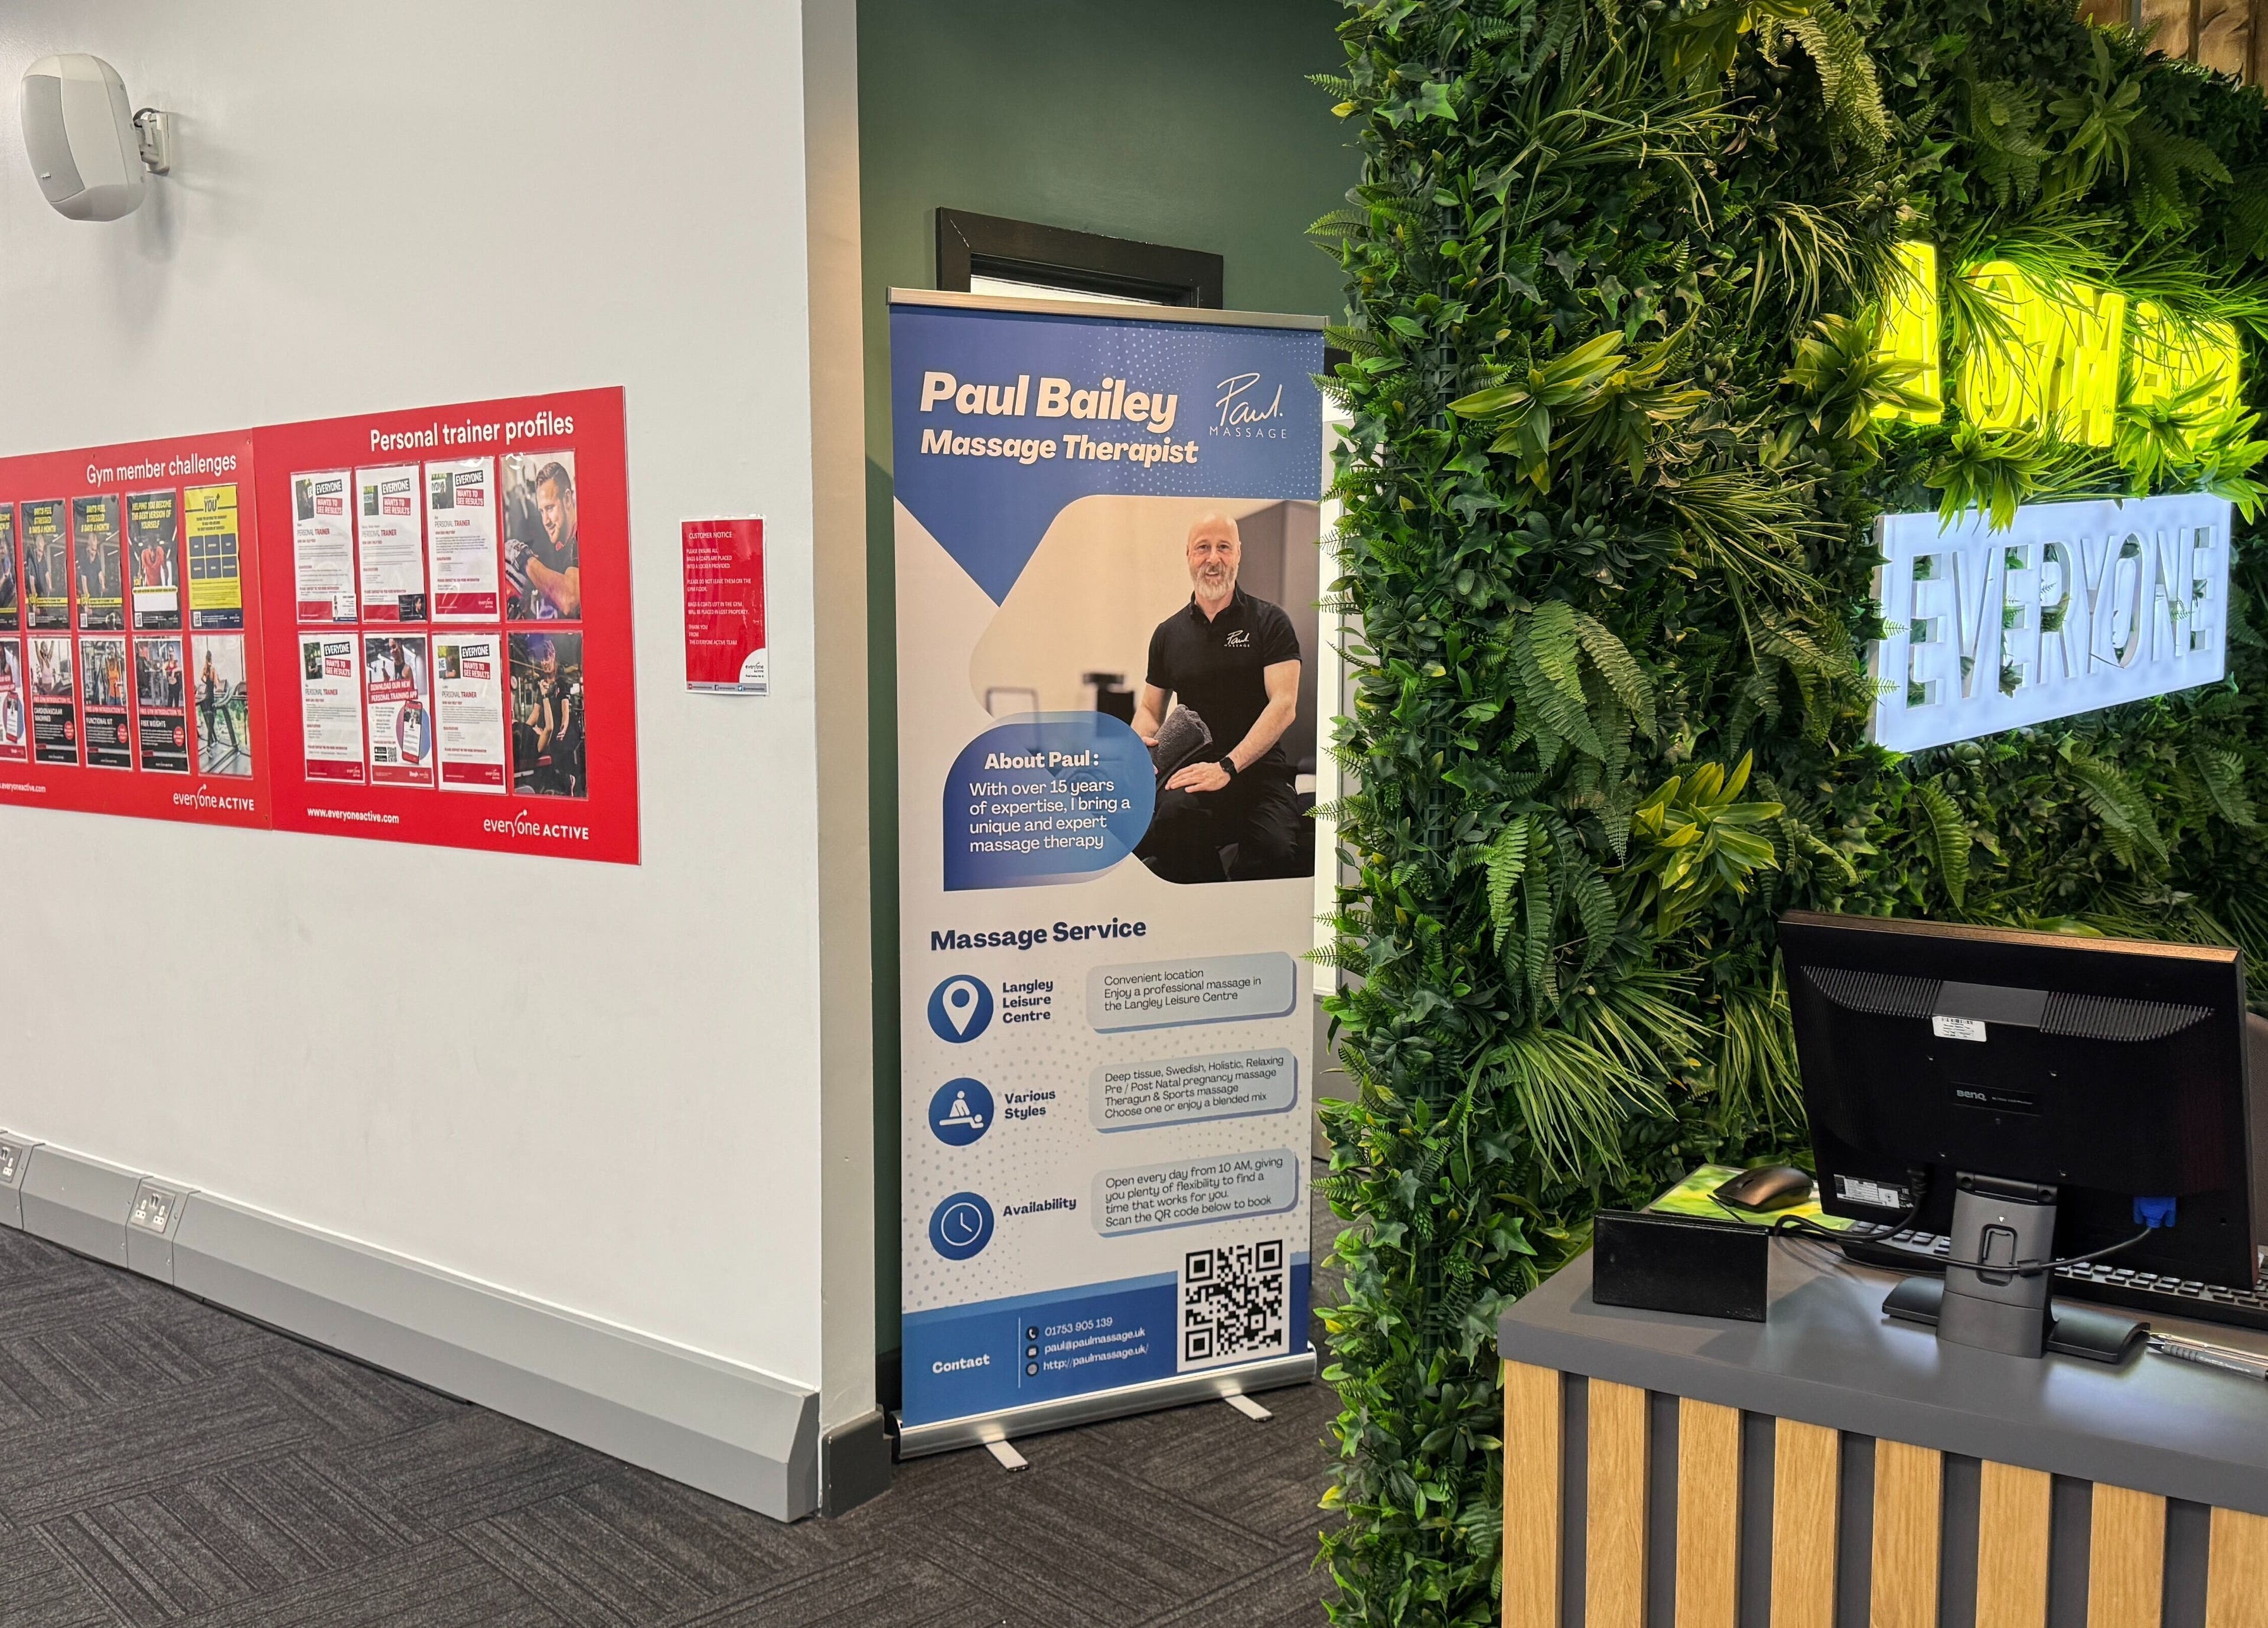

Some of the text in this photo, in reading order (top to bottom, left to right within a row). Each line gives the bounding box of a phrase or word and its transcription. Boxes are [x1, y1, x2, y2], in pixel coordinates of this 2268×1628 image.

[920, 371, 1178, 434] Paul Bailey
[371, 411, 573, 451] Personal trainer profiles
[1210, 426, 1287, 438] MASSAGE
[921, 429, 1199, 467] Massage Therapist
[87, 453, 236, 487] Gym member challenges
[455, 472, 483, 485] EVERYONE
[317, 481, 341, 494] EVERYONE
[383, 480, 409, 493] EVERYONE
[1907, 526, 2213, 709] EVERYONE
[462, 646, 488, 657] EVERYONE
[985, 753, 1045, 770] About
[1049, 750, 1090, 767] Paul
[0, 783, 46, 793] .everyoneactive.com
[173, 784, 254, 810] everyone ACTIVE
[969, 780, 1114, 796] With over 15 years
[307, 808, 399, 823] www.everyoneactive.com
[969, 797, 1131, 817] of expertise, I bring a
[484, 809, 589, 840] everyone ACTIVE
[970, 815, 1107, 836] unique and expert
[970, 835, 1104, 853] massage therapy
[931, 917, 1146, 950] Massage Service
[1003, 979, 1054, 993] Langley
[1104, 969, 1204, 986] Convenient location
[1104, 988, 1132, 1000] Enjoy
[1143, 981, 1204, 997] professional
[1207, 978, 1250, 988] massage
[1253, 976, 1261, 985] in
[1003, 996, 1051, 1008] Leisure
[1104, 991, 1238, 1011] the Langley Leisure Centre
[1003, 1010, 1051, 1023] Centre
[1105, 1056, 1283, 1082] Deep tissue, Swedish, Holistic, Relaxing
[1105, 1086, 1122, 1094] Pre
[1131, 1082, 1153, 1092] Post
[1156, 1077, 1181, 1088] Natal
[1183, 1073, 1233, 1087] pregnancy
[1236, 1069, 1276, 1080] massage
[1005, 1088, 1056, 1104] Various
[1105, 1108, 1142, 1118] Choose
[1178, 1100, 1202, 1111] enjoy
[1213, 1095, 1249, 1106] blended
[1252, 1092, 1267, 1102] mix
[1106, 1085, 1239, 1106] Theragun & Sports massage
[1005, 1104, 1047, 1119] Styles
[1106, 1157, 1283, 1189] Open every day from 10 AM, giving
[1106, 1192, 1125, 1203] you
[1128, 1186, 1160, 1199] plenty
[1162, 1183, 1174, 1193] of
[1177, 1178, 1220, 1191] flexibility
[1223, 1177, 1234, 1185] to
[1237, 1172, 1255, 1183] find
[1003, 1197, 1077, 1217] Availability
[1106, 1190, 1228, 1214] time that works for you.
[1106, 1196, 1271, 1227] Scan the QR code below to book
[1045, 1317, 1112, 1336] 01753 905 139
[1044, 1327, 1145, 1355] paul@paulmassage.uk
[933, 1354, 990, 1374] Contact
[1044, 1344, 1148, 1370] http://paulmassage.uk/
